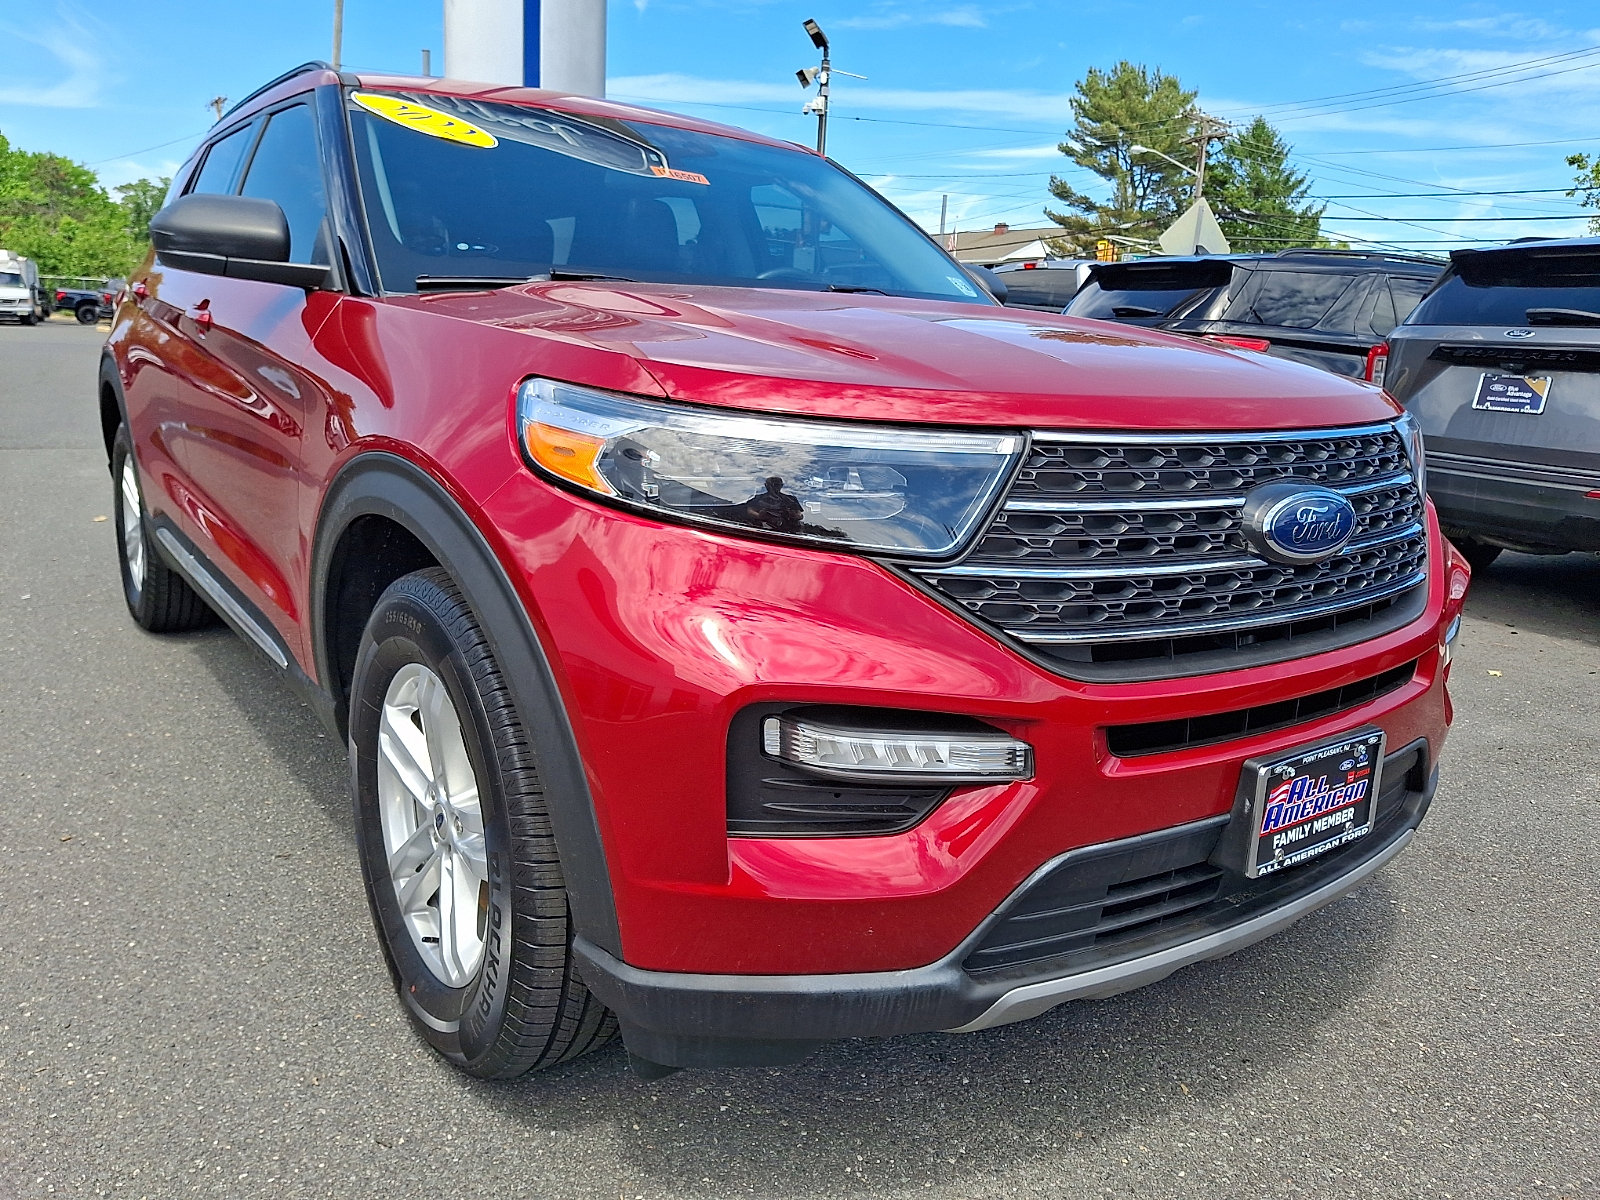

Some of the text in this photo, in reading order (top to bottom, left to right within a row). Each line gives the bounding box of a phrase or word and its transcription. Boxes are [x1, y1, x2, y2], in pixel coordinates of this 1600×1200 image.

[1293, 506, 1340, 544] Ford
[1303, 755, 1317, 765] POINT
[1286, 775, 1329, 805] ALL
[1273, 807, 1355, 849] FAMILY MEMBER
[1259, 827, 1369, 876] ALL AMERICAN FORD
